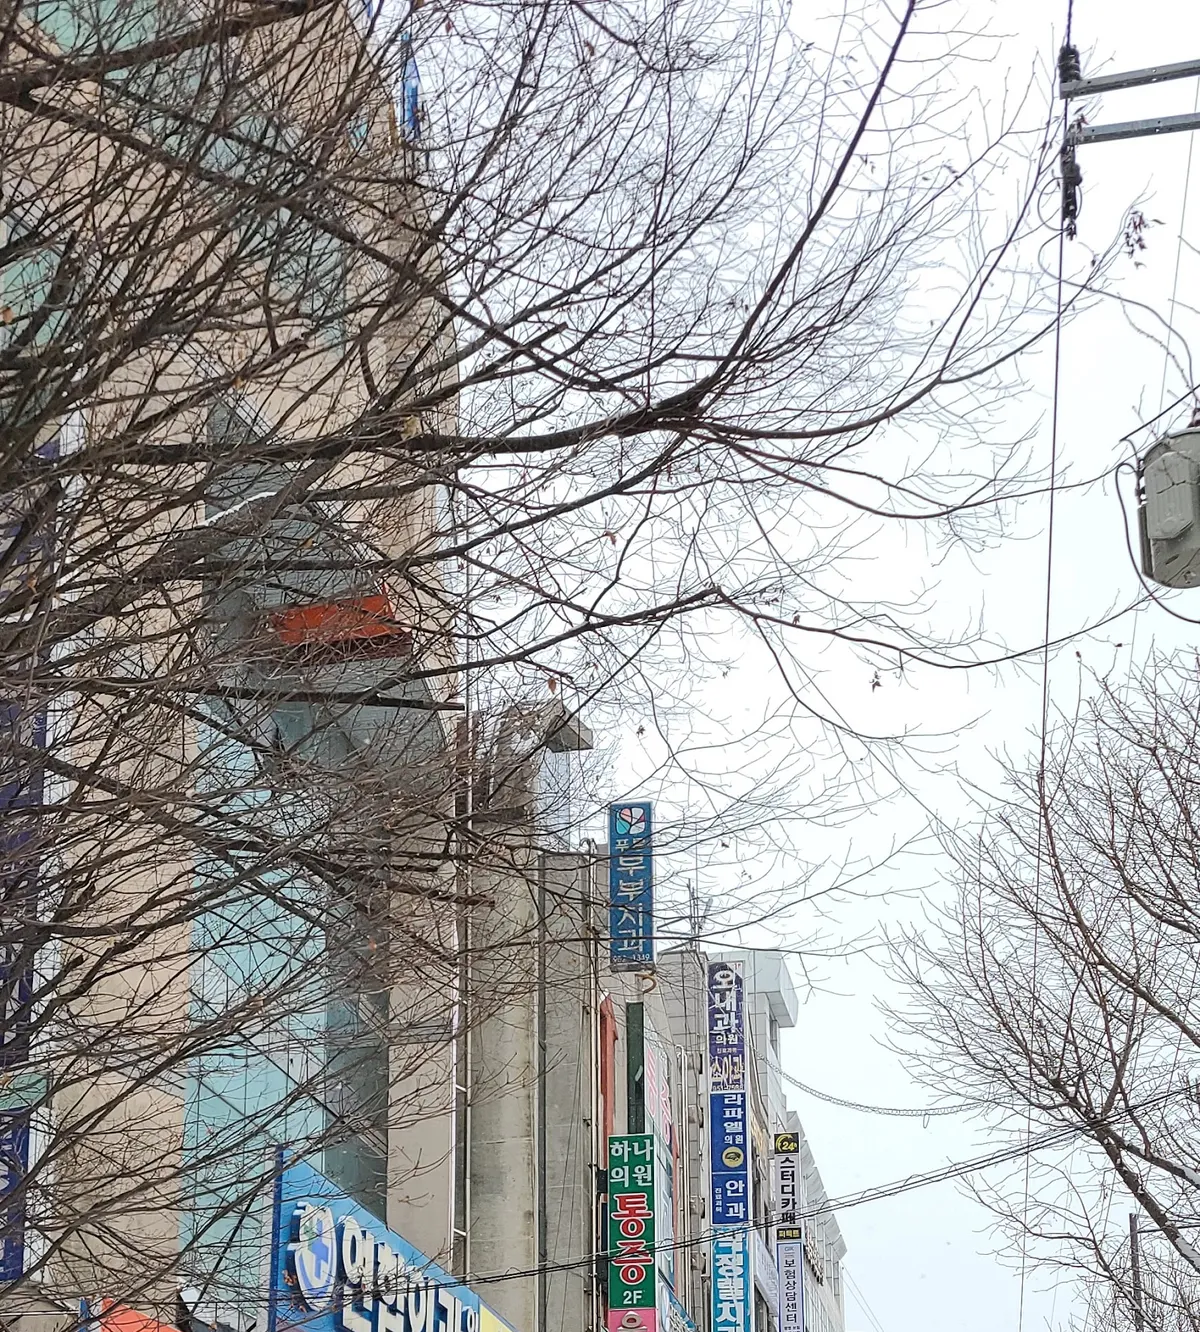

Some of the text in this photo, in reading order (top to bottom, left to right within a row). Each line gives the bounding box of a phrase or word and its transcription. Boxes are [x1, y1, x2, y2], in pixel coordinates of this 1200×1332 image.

[723, 1094, 743, 1132] 라파엘
[610, 1138, 653, 1162] 하나
[724, 1135, 743, 1144] 의원
[610, 1165, 652, 1188] 의원
[780, 1157, 796, 1224] 스터디카페
[726, 1181, 745, 1218] 안과
[611, 1192, 654, 1286] 통증
[623, 1290, 642, 1304] 2F
[784, 1259, 797, 1323] 보험상담센터
